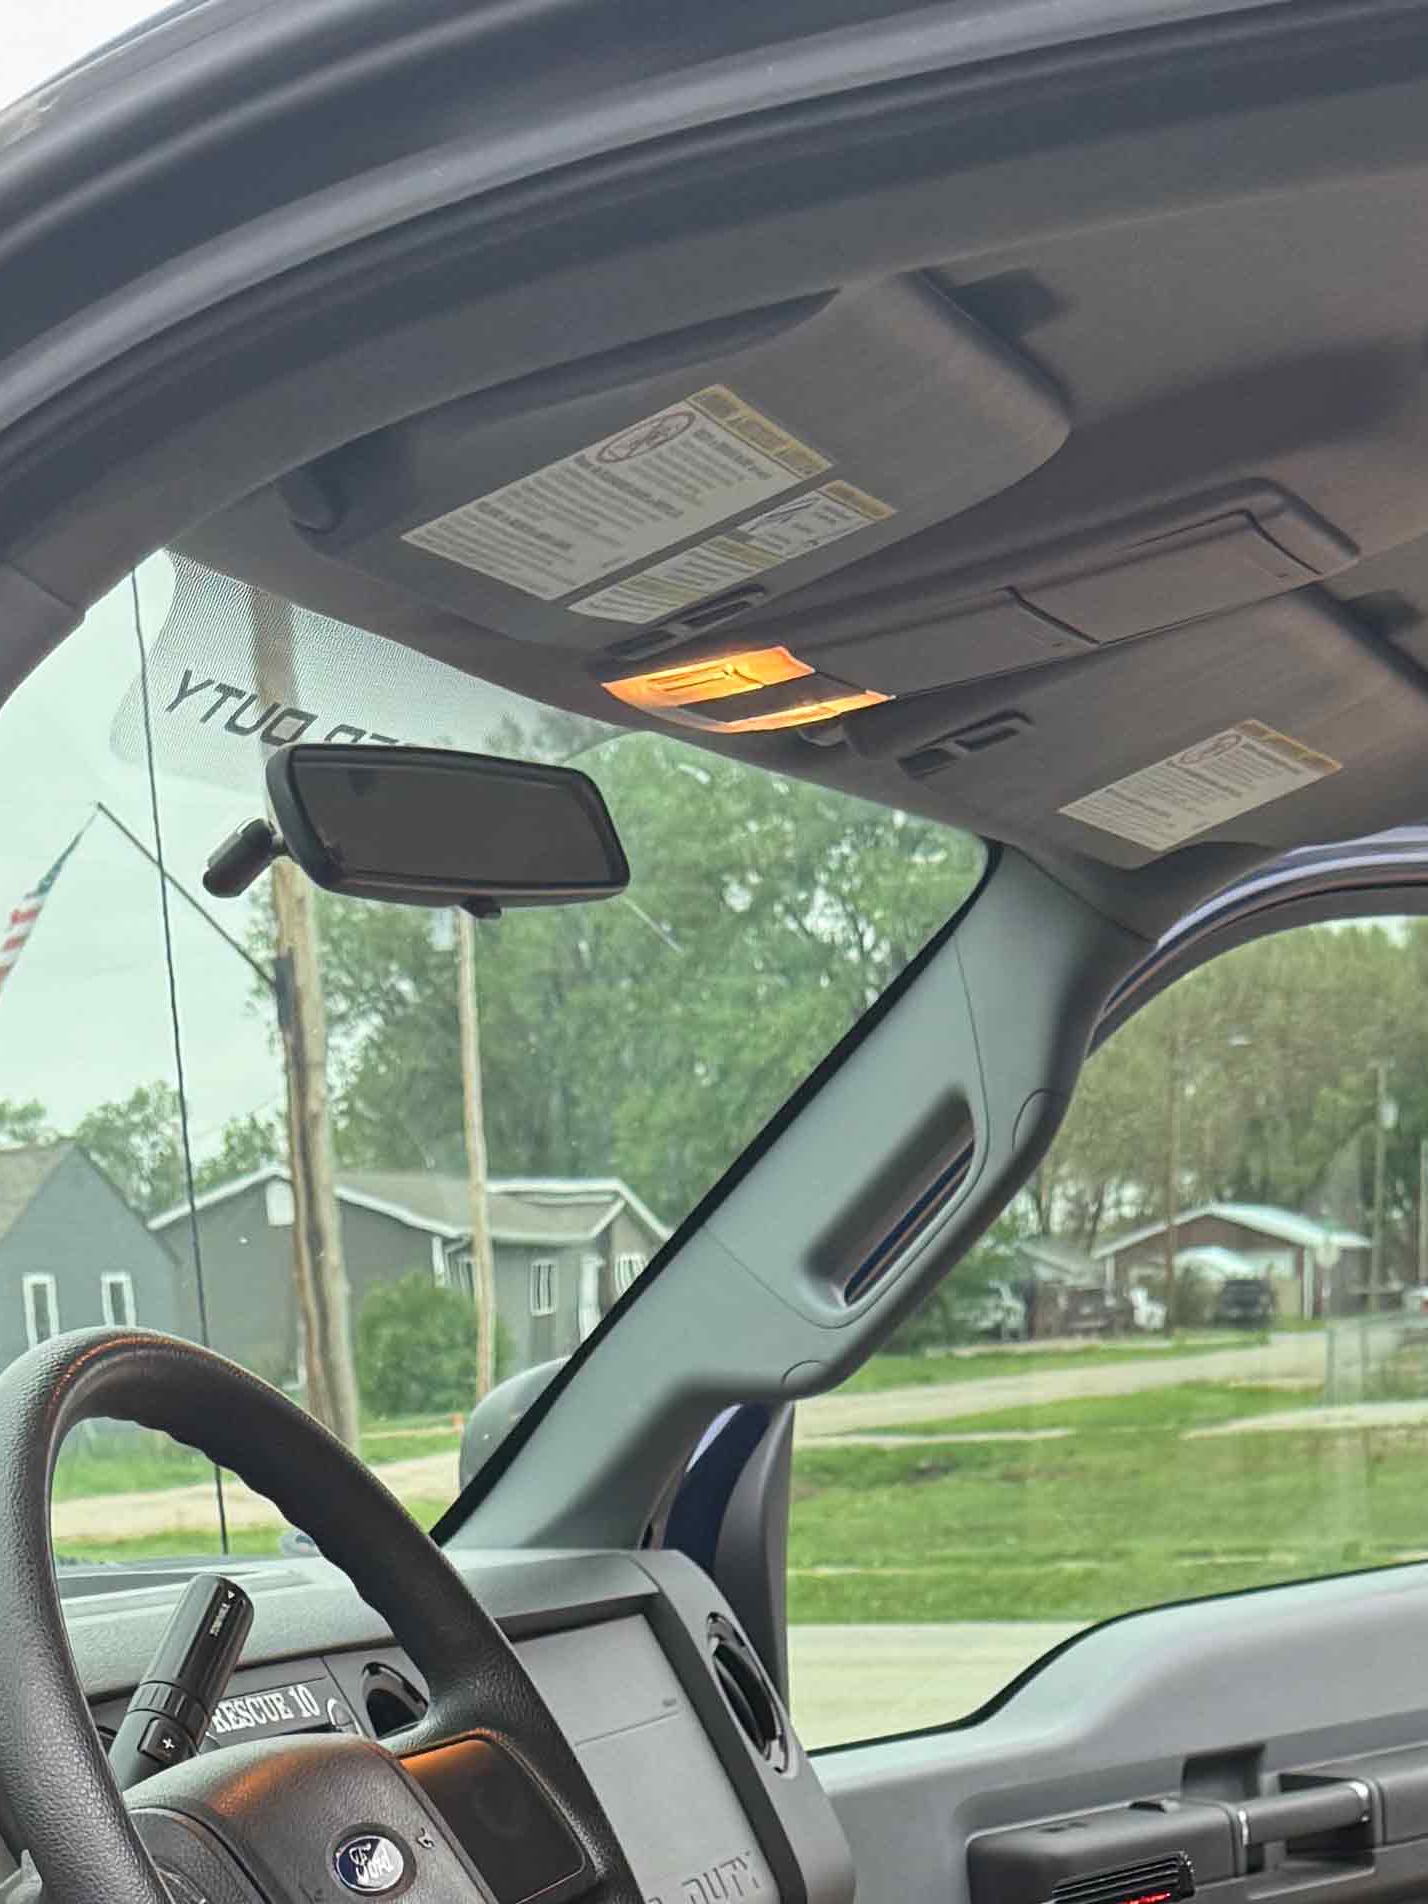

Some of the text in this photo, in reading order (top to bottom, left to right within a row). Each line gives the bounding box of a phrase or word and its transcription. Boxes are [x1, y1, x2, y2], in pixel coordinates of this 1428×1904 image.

[211, 1684, 321, 1734] RESCUE 10
[345, 1840, 398, 1887] Ford
